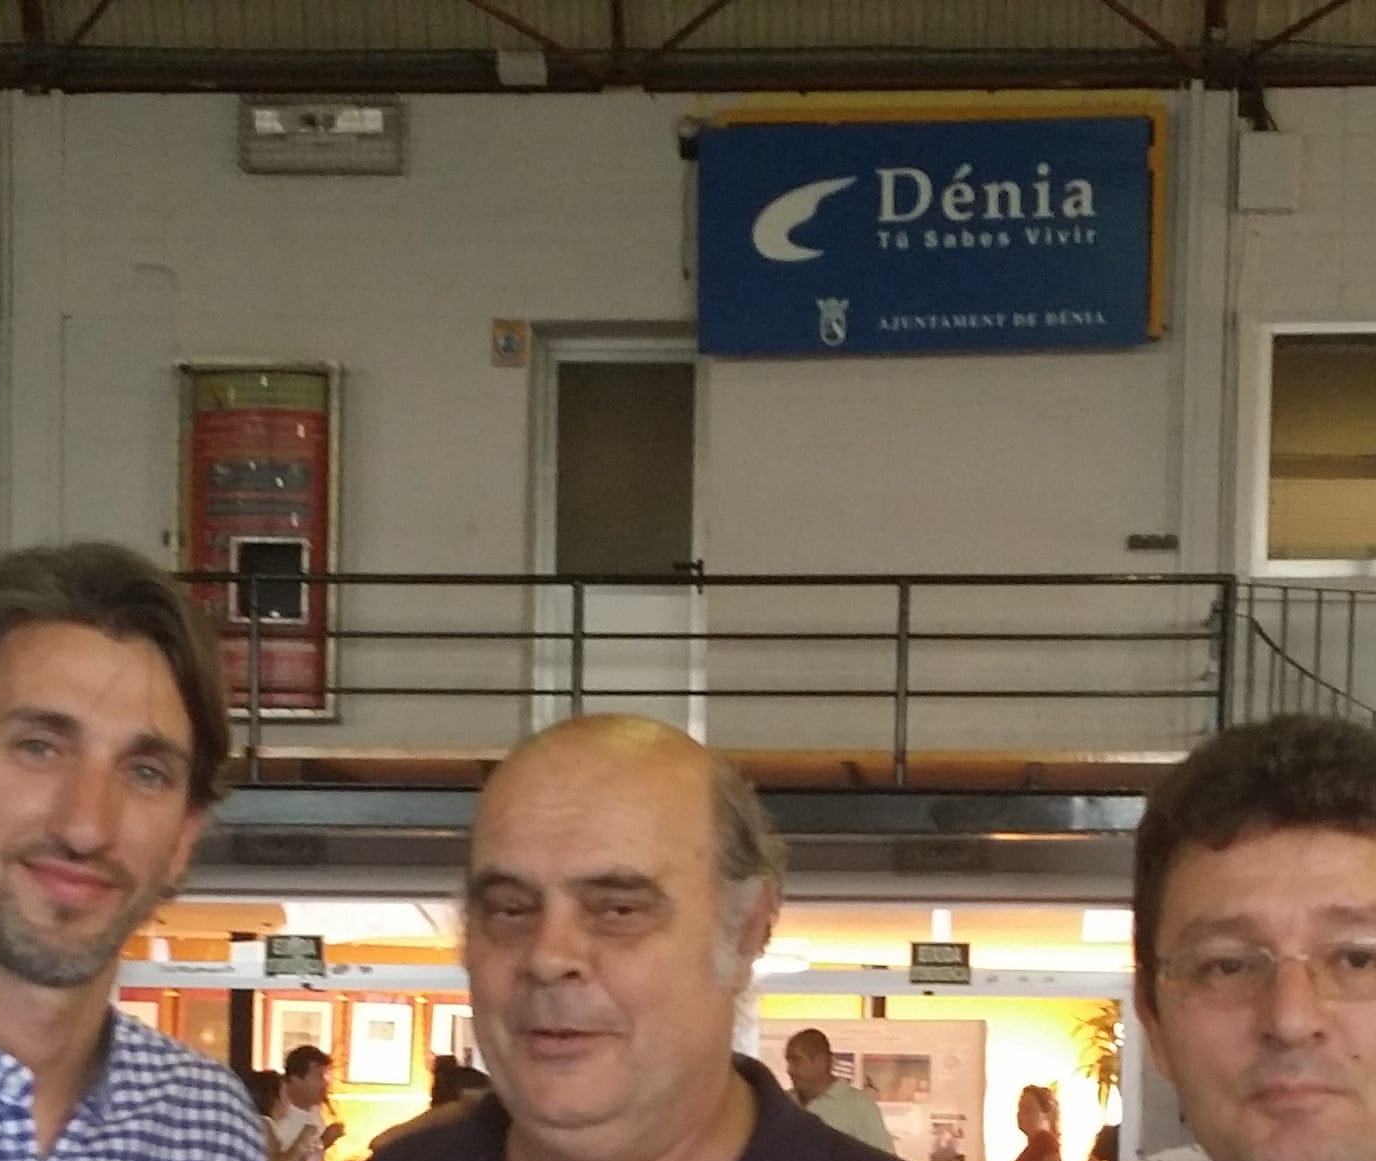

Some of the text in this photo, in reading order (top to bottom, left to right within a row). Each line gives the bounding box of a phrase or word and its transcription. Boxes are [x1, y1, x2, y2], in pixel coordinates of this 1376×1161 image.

[875, 161, 1097, 223] Dénia
[923, 228, 1011, 249] Sabes
[1025, 224, 1097, 245] Vivir
[880, 312, 1006, 331] AJUNTAMENT
[1012, 312, 1037, 329] DE
